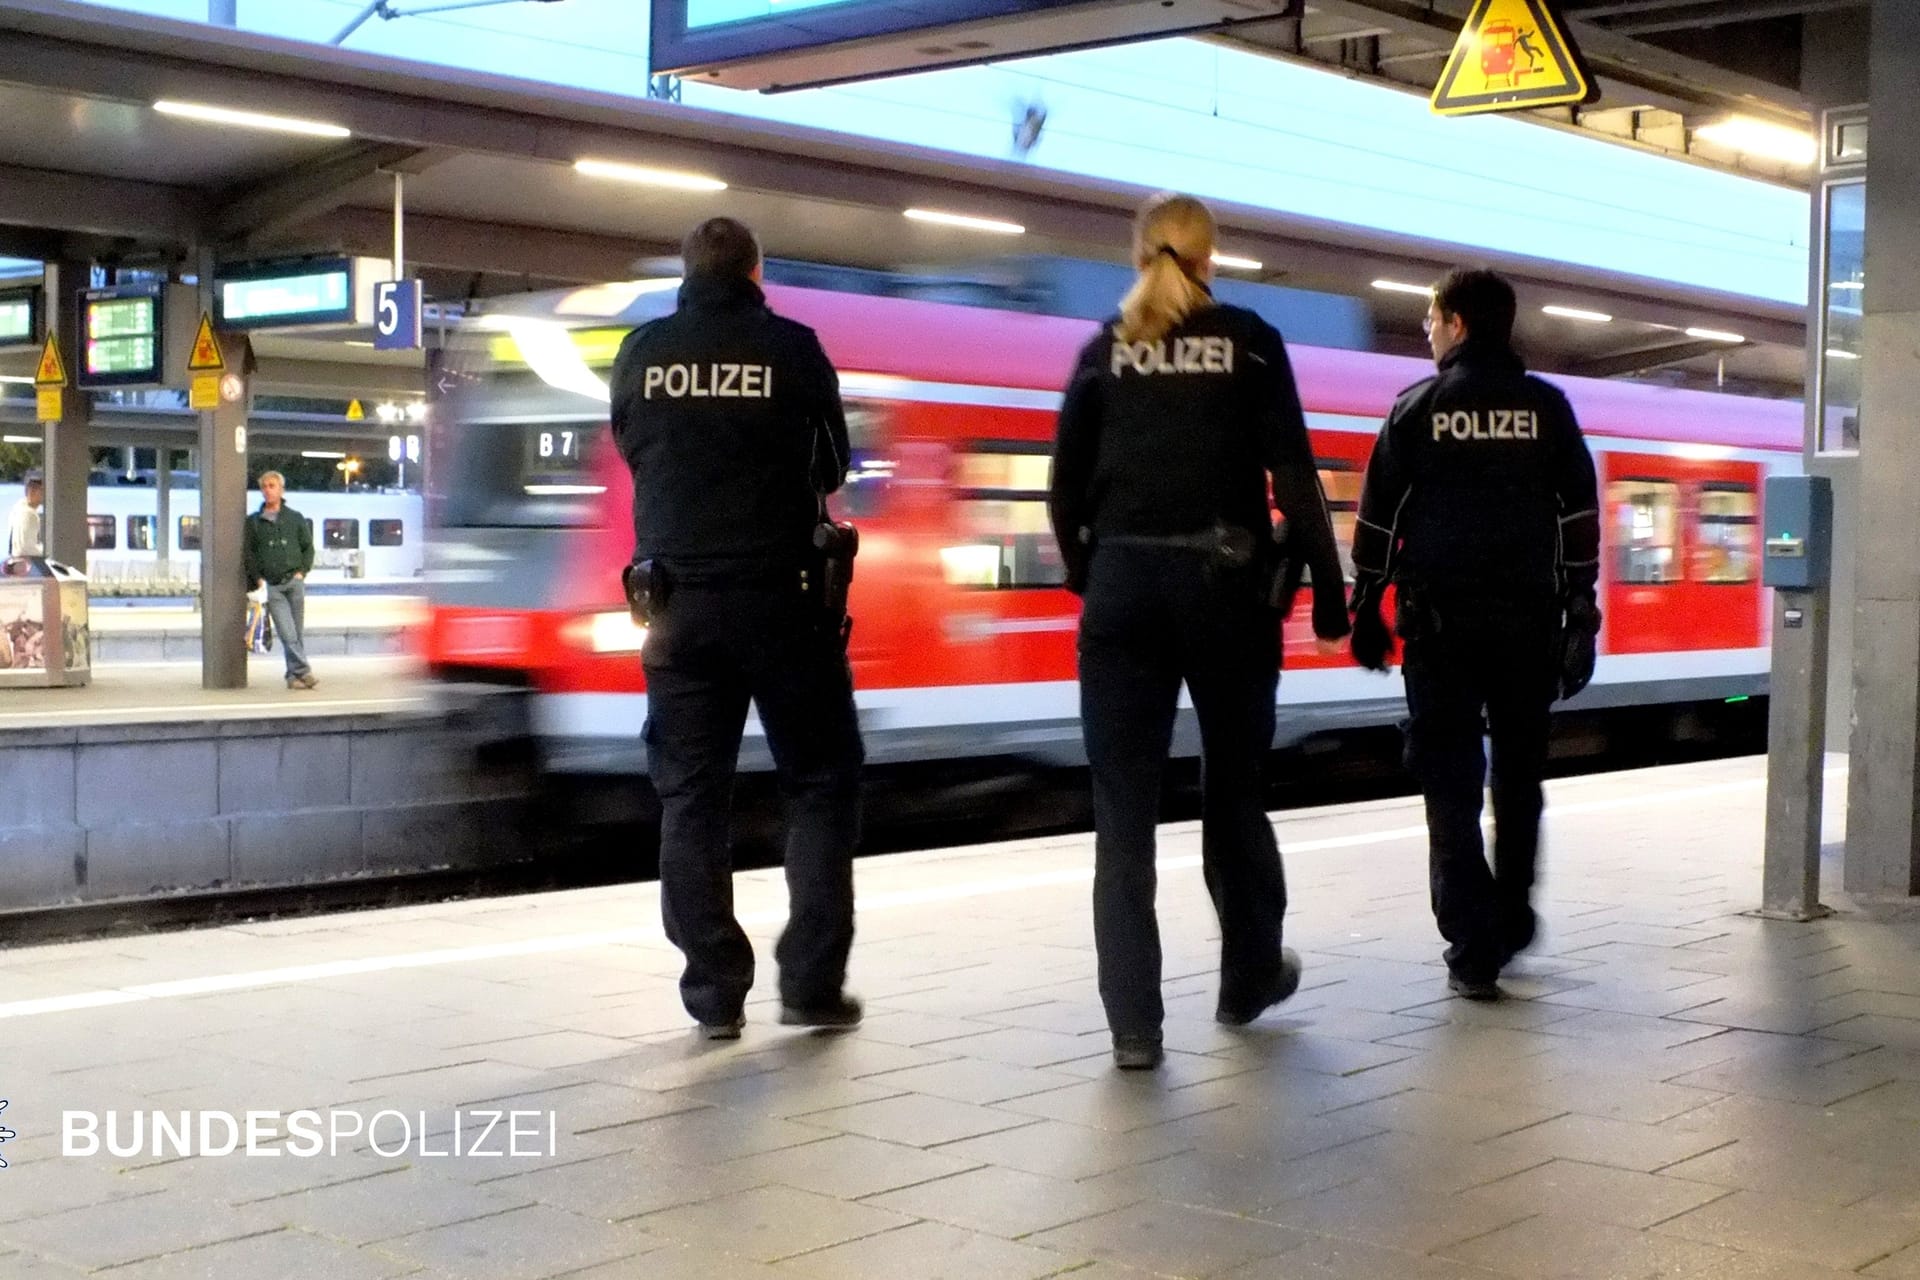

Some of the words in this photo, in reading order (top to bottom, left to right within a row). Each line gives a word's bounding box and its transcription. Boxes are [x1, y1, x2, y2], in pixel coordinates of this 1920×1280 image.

[378, 283, 399, 335] 5
[1111, 336, 1234, 378] POLIZEI
[644, 363, 772, 399] POLIZEI
[1433, 410, 1537, 441] POLIZEI
[540, 433, 553, 457] B
[561, 431, 573, 456] 7
